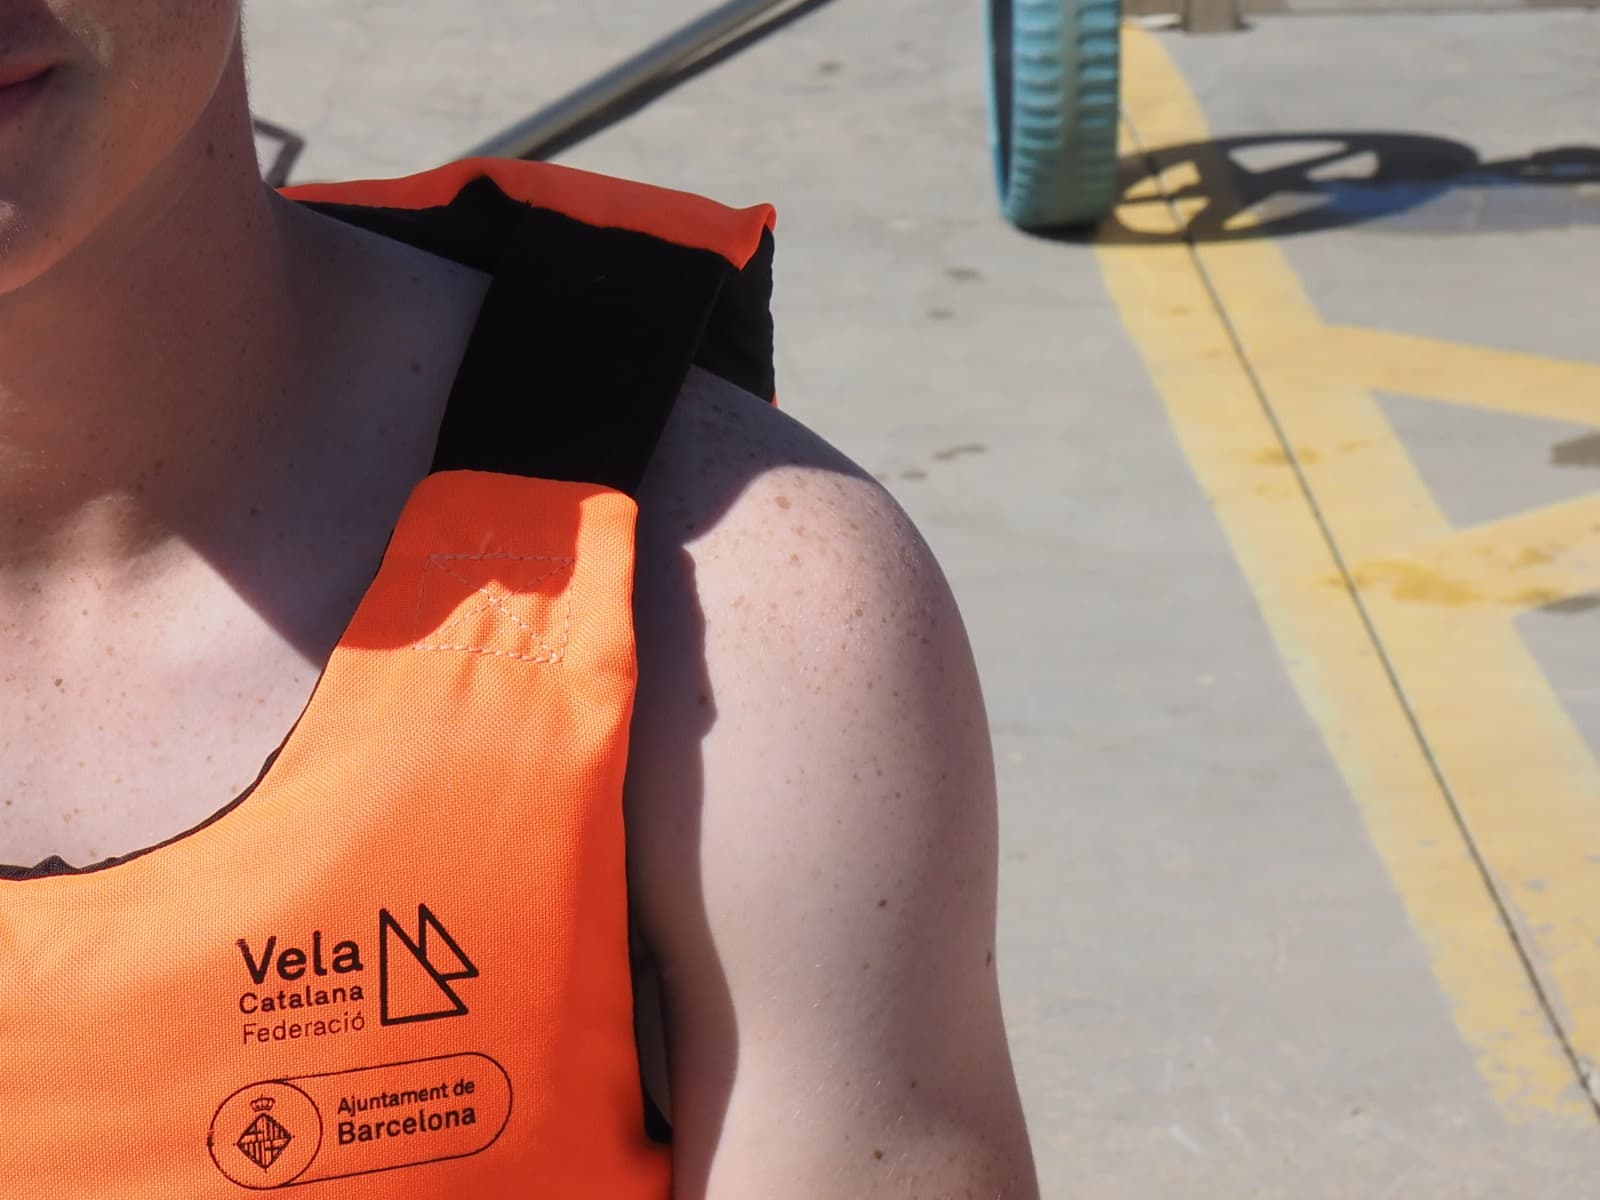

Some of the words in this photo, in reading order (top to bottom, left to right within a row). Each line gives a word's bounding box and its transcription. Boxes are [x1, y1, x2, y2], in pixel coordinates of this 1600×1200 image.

[235, 930, 363, 985] Vela
[239, 985, 365, 1014] Catalana
[243, 1010, 365, 1045] Federació
[337, 1082, 448, 1117] Ajuntament
[453, 1078, 475, 1096] de
[338, 1107, 476, 1145] Barcelona
